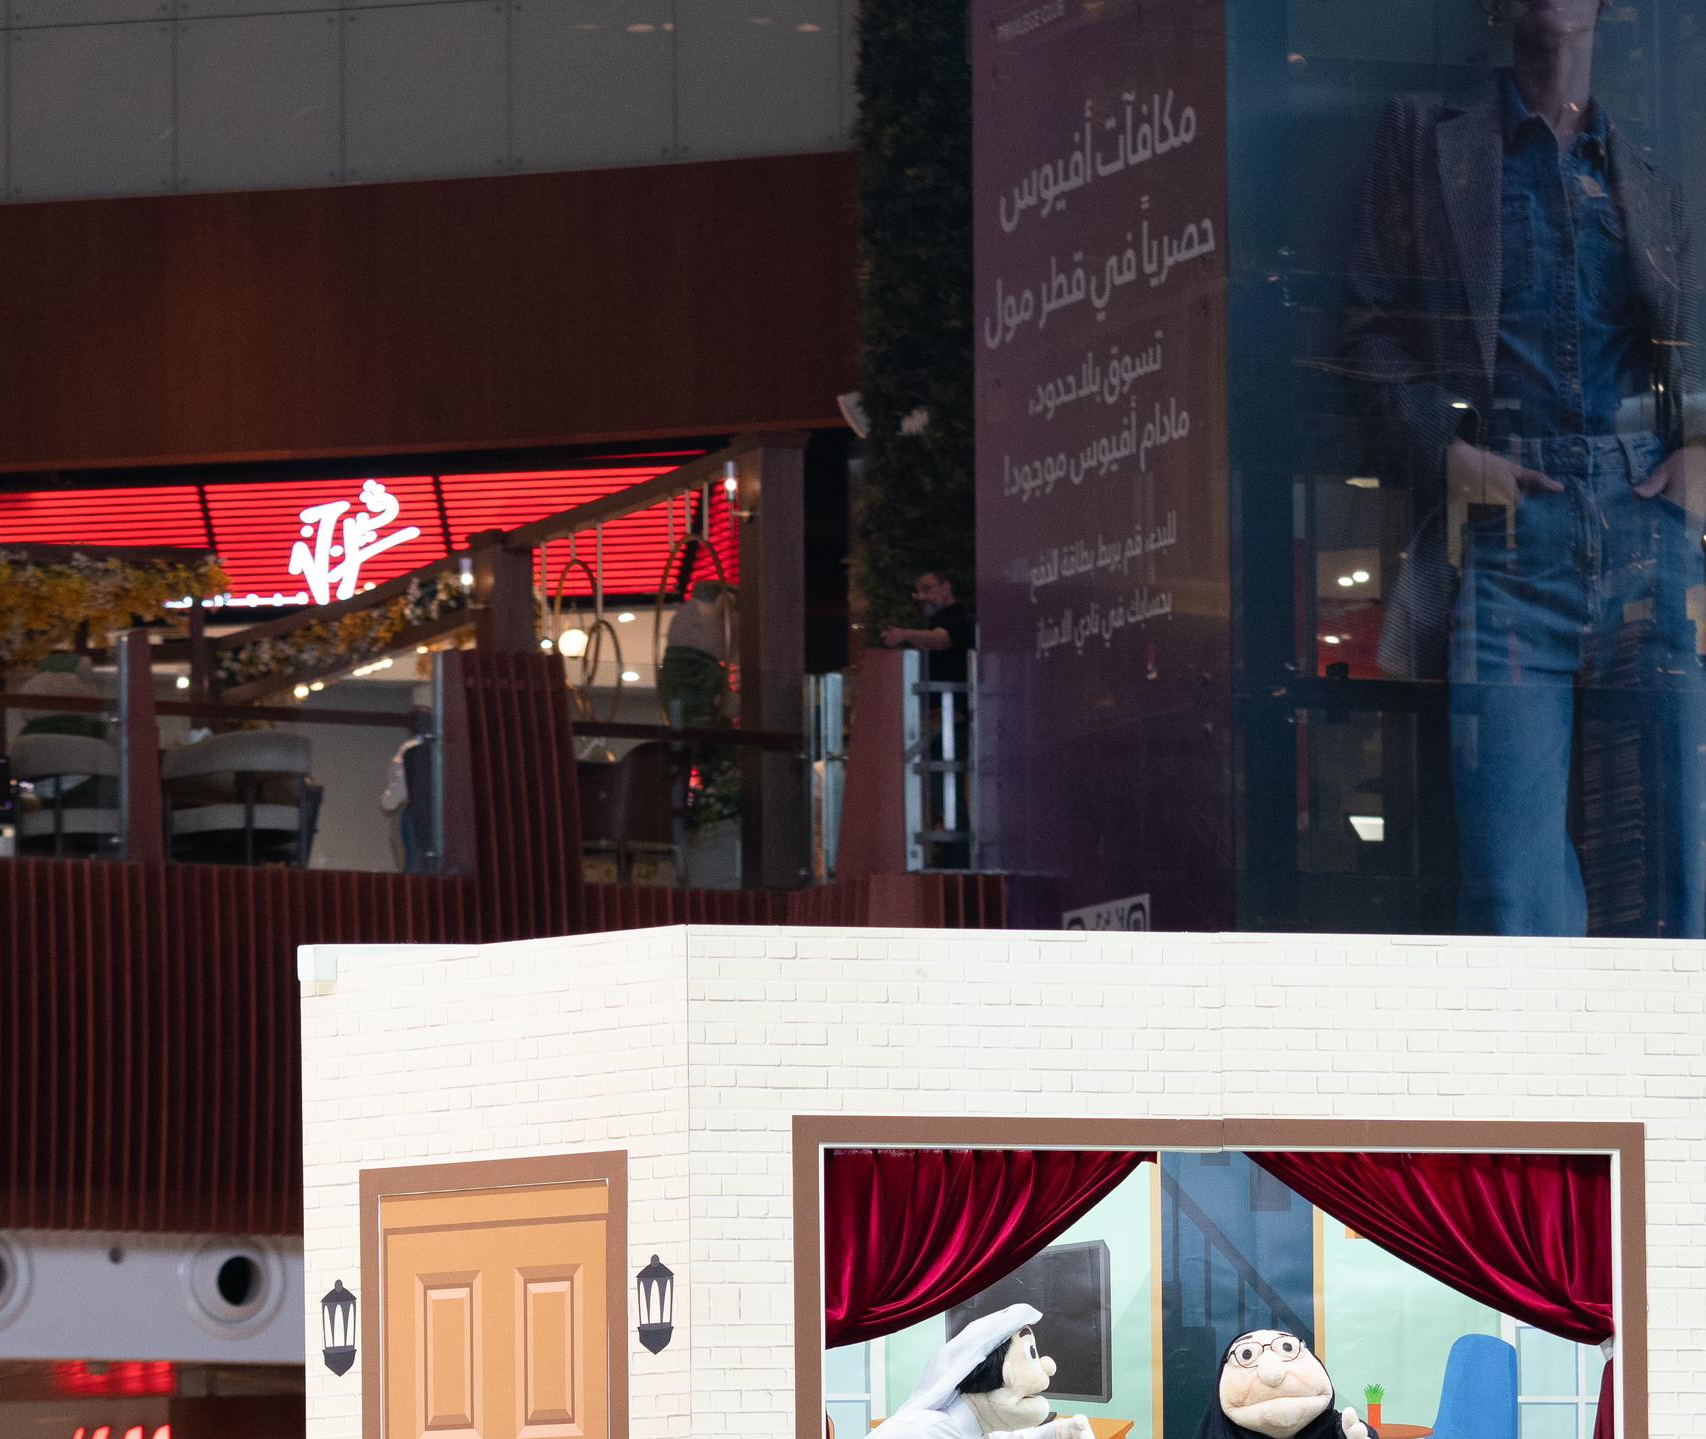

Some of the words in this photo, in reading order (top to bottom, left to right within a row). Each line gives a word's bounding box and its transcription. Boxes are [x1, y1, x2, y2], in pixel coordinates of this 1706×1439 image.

[999, 99, 1093, 233] أفيوس
[1095, 90, 1197, 178] مكافآت
[984, 279, 1036, 349] مول
[1039, 251, 1087, 329] قطر
[1090, 232, 1137, 322] في
[1077, 350, 1101, 403] بلا
[1103, 329, 1163, 405] تسوق
[1069, 395, 1138, 485] أفيوس
[1101, 596, 1126, 648] في
